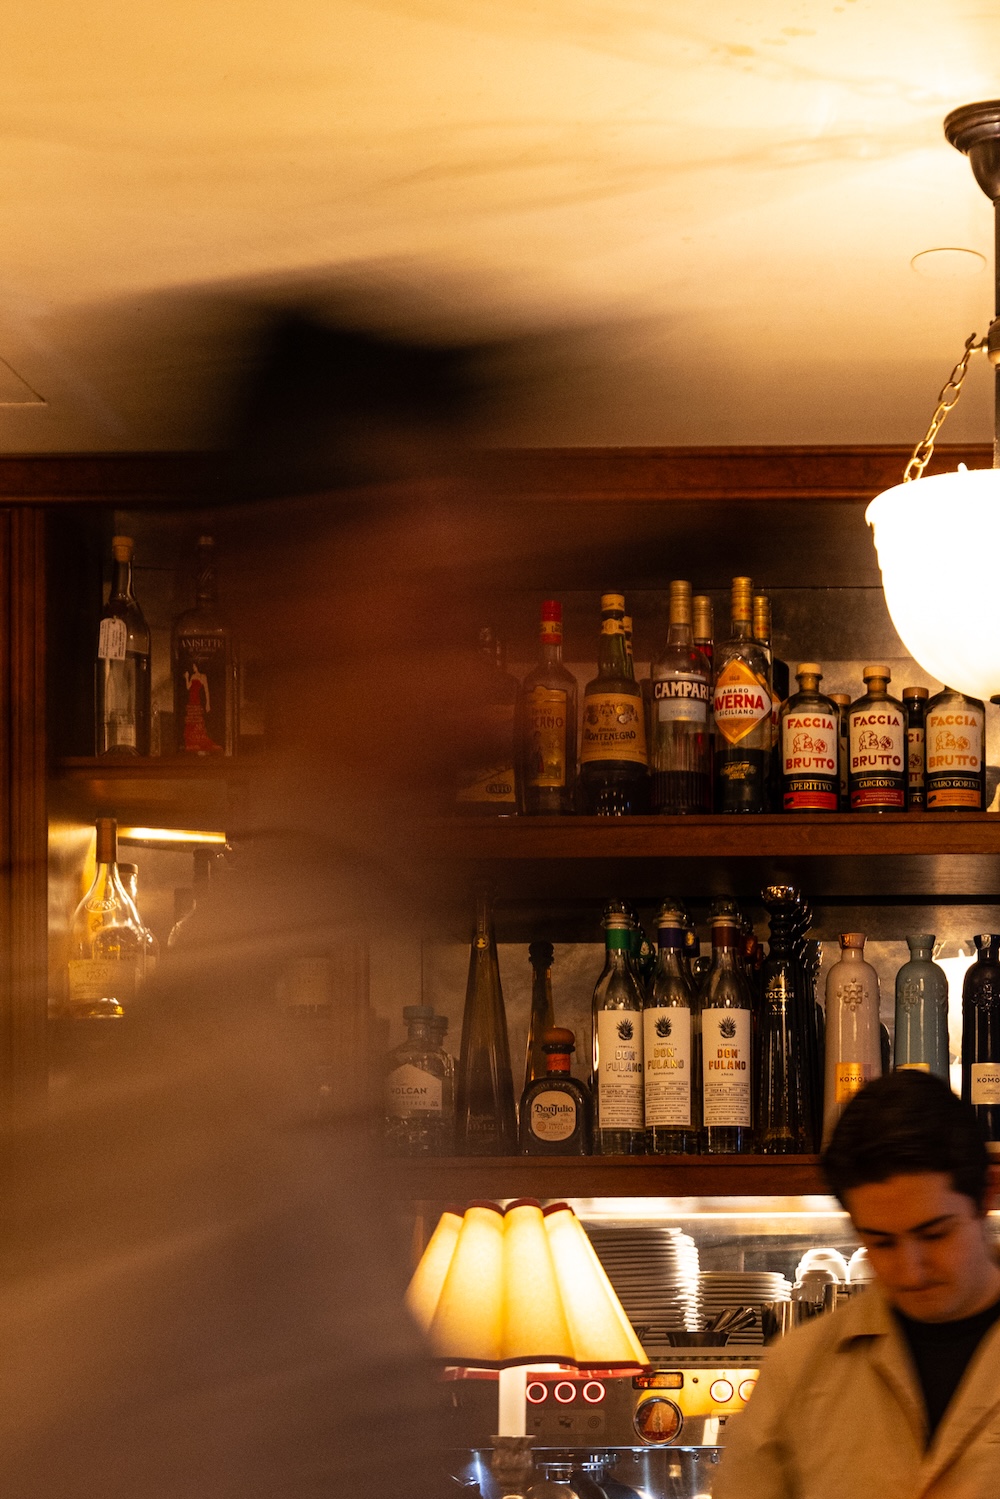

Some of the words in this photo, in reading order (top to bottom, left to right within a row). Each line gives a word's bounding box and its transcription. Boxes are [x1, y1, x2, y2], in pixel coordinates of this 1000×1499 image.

[654, 681, 709, 700] CAMPARI
[787, 718, 834, 729] FACCIA
[853, 715, 900, 727] FACCIA
[930, 715, 977, 727] FACCIA
[786, 757, 835, 770] BRUTTO
[852, 755, 901, 768] BRUTTO
[928, 754, 978, 768] BRUTTO
[789, 782, 832, 791] APERITIVO
[859, 780, 895, 788] CARCIOFO
[615, 1050, 635, 1061] DON
[653, 1048, 675, 1058] DON
[717, 1048, 738, 1059] DON
[606, 1062, 642, 1073] FULANO
[647, 1059, 684, 1070] FULANO
[708, 1060, 746, 1071] FULANO
